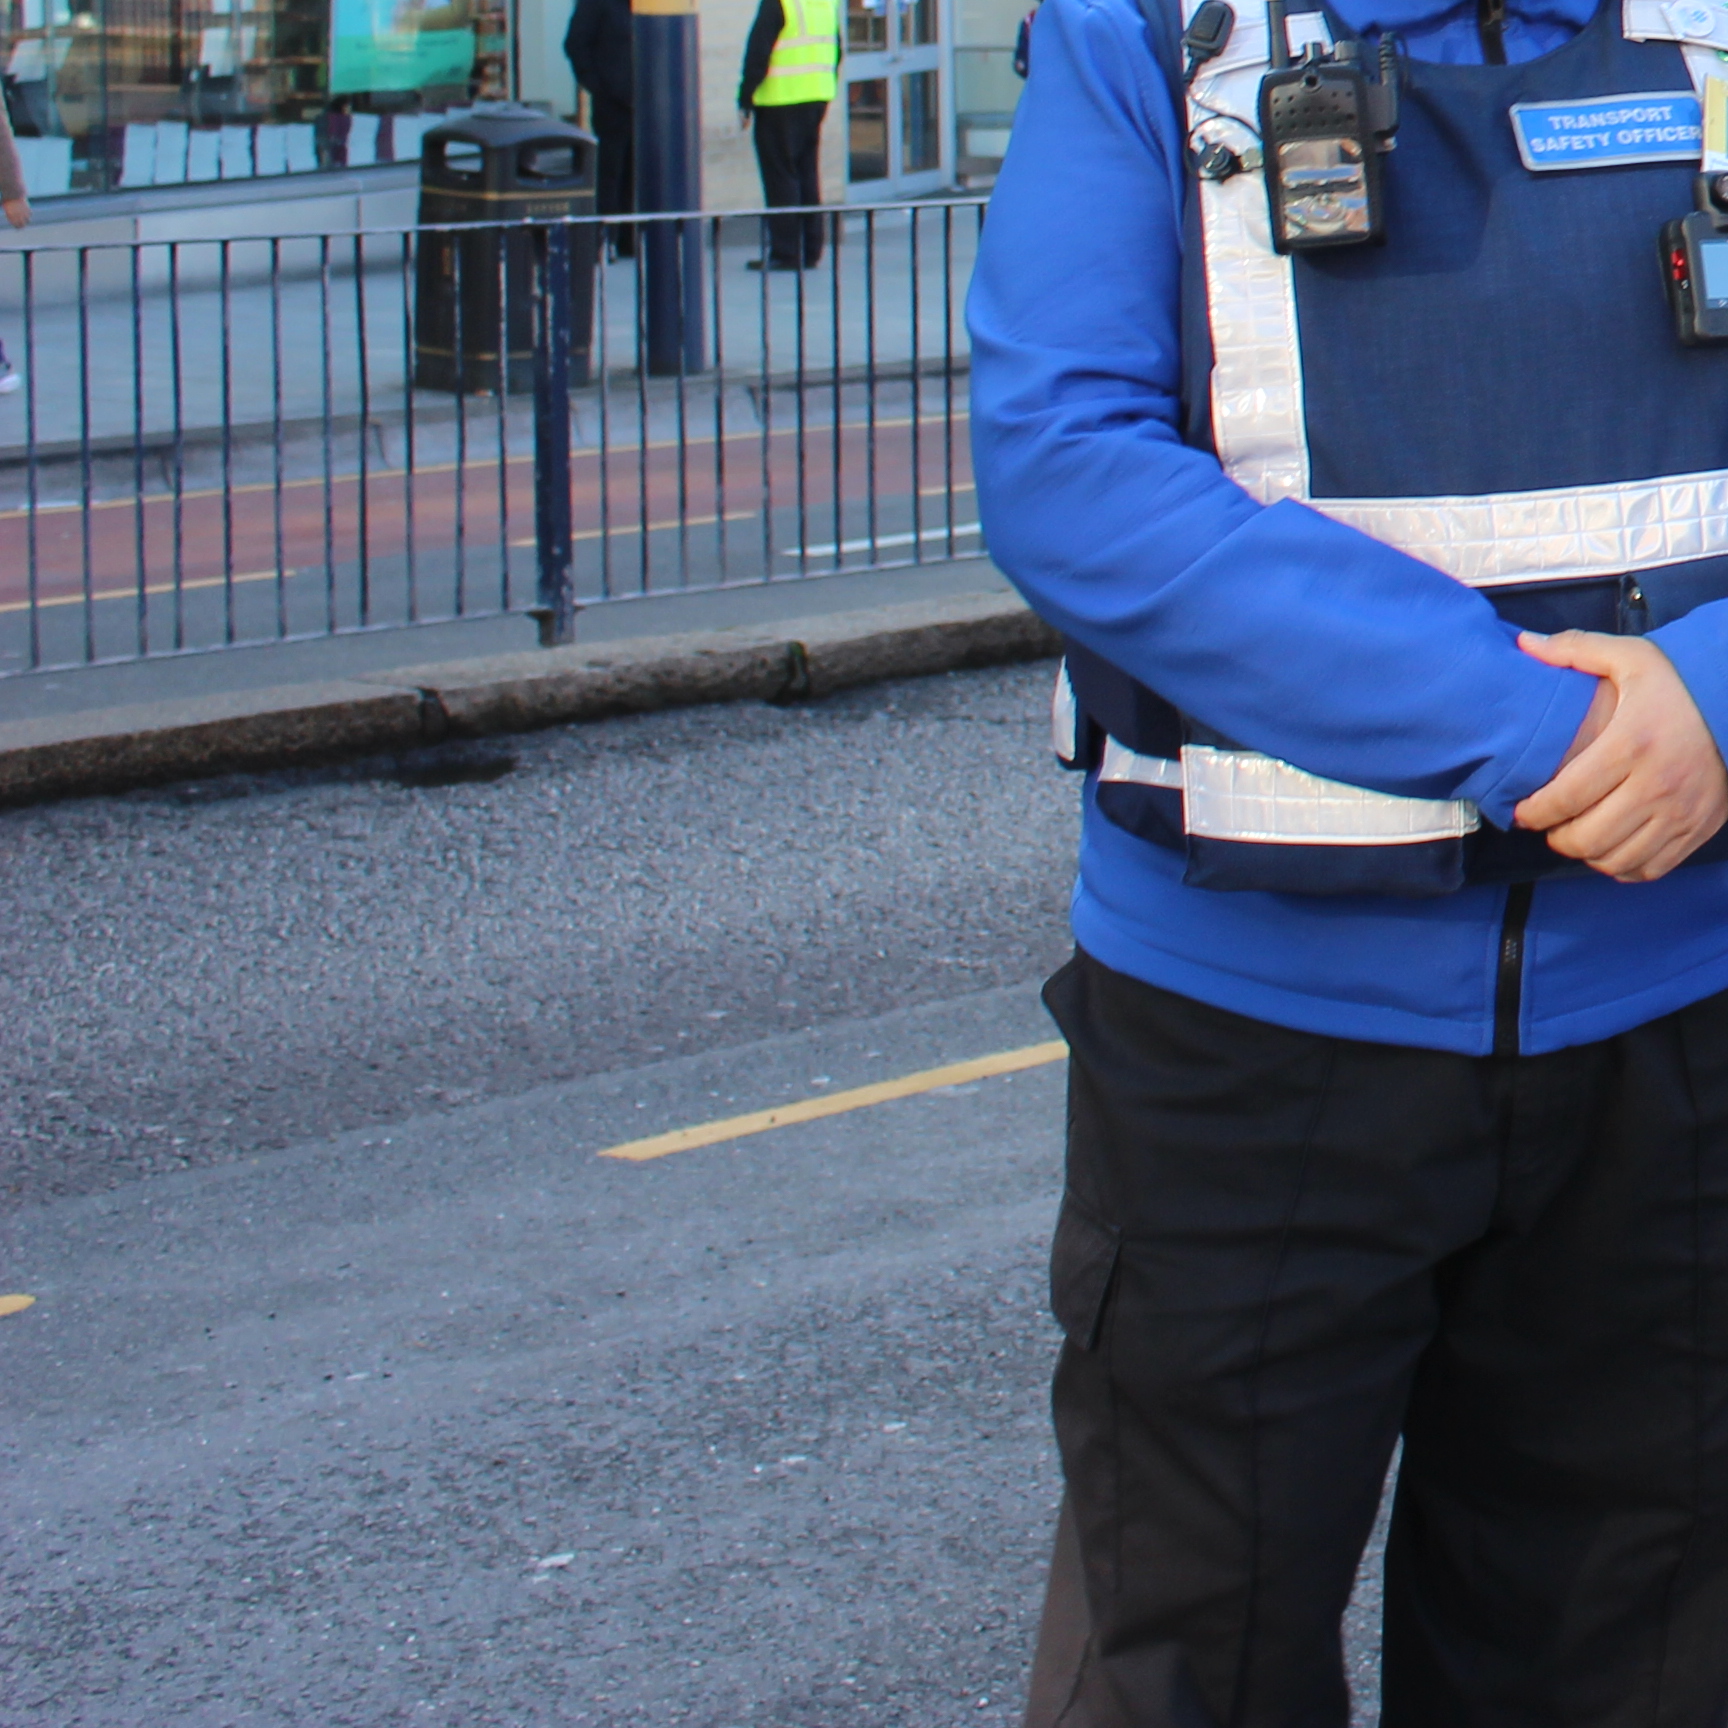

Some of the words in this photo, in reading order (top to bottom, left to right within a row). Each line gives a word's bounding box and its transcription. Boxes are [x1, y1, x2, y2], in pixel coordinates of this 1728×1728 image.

[1548, 105, 1674, 131] TRANSPORT
[1529, 131, 1610, 154] SAFETY
[1616, 125, 1702, 145] OFFICER
